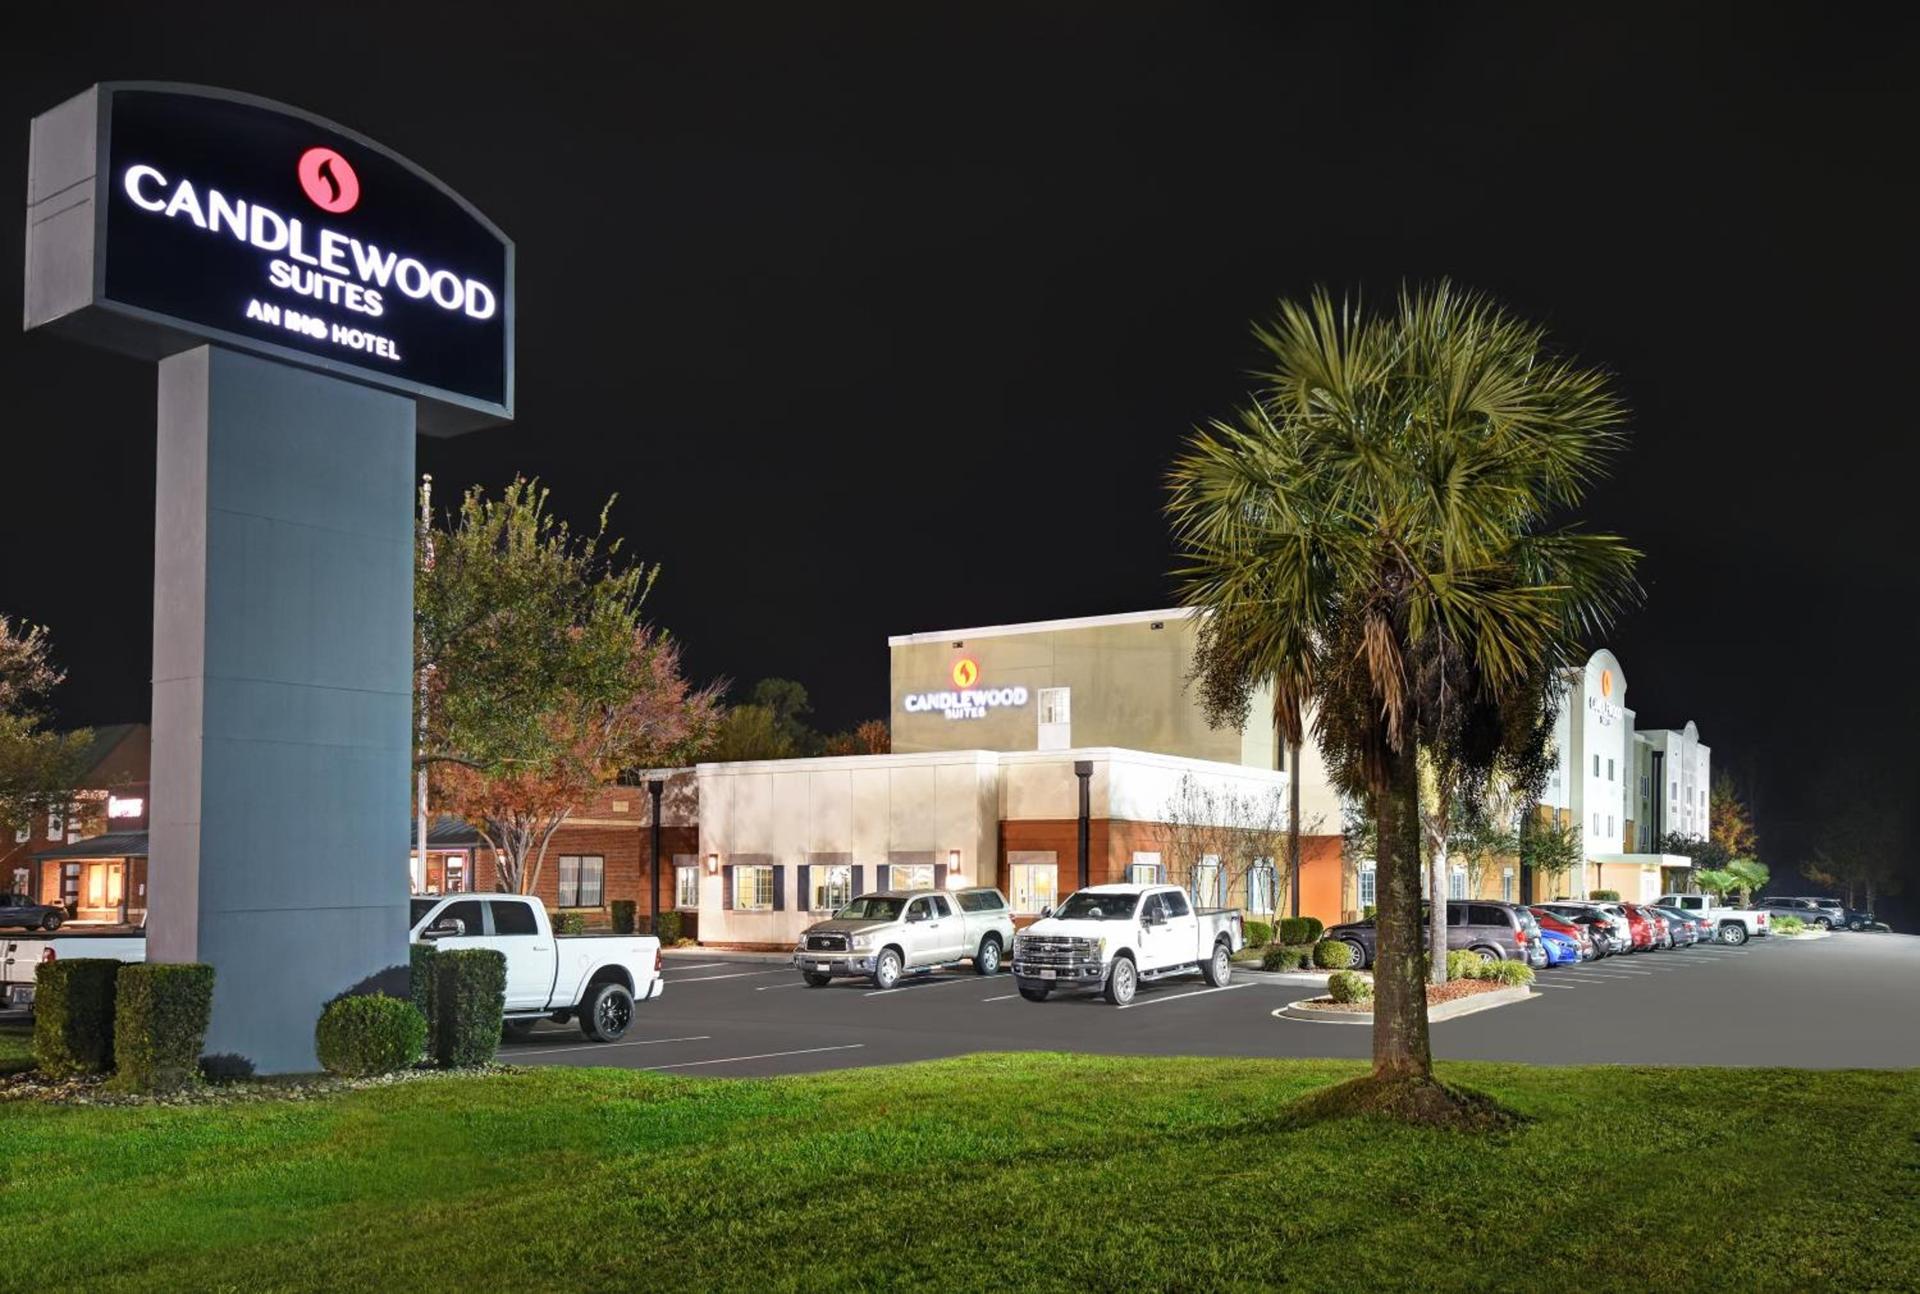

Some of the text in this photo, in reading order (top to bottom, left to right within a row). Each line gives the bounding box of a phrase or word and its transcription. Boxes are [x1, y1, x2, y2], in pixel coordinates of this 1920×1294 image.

[124, 165, 496, 319] CANDLEWOOD
[269, 259, 383, 317] SUITES
[246, 299, 281, 326] AN
[331, 323, 400, 360] HOTEL
[904, 687, 1028, 711] CANDLEWOOD
[944, 707, 986, 720] SUITES
